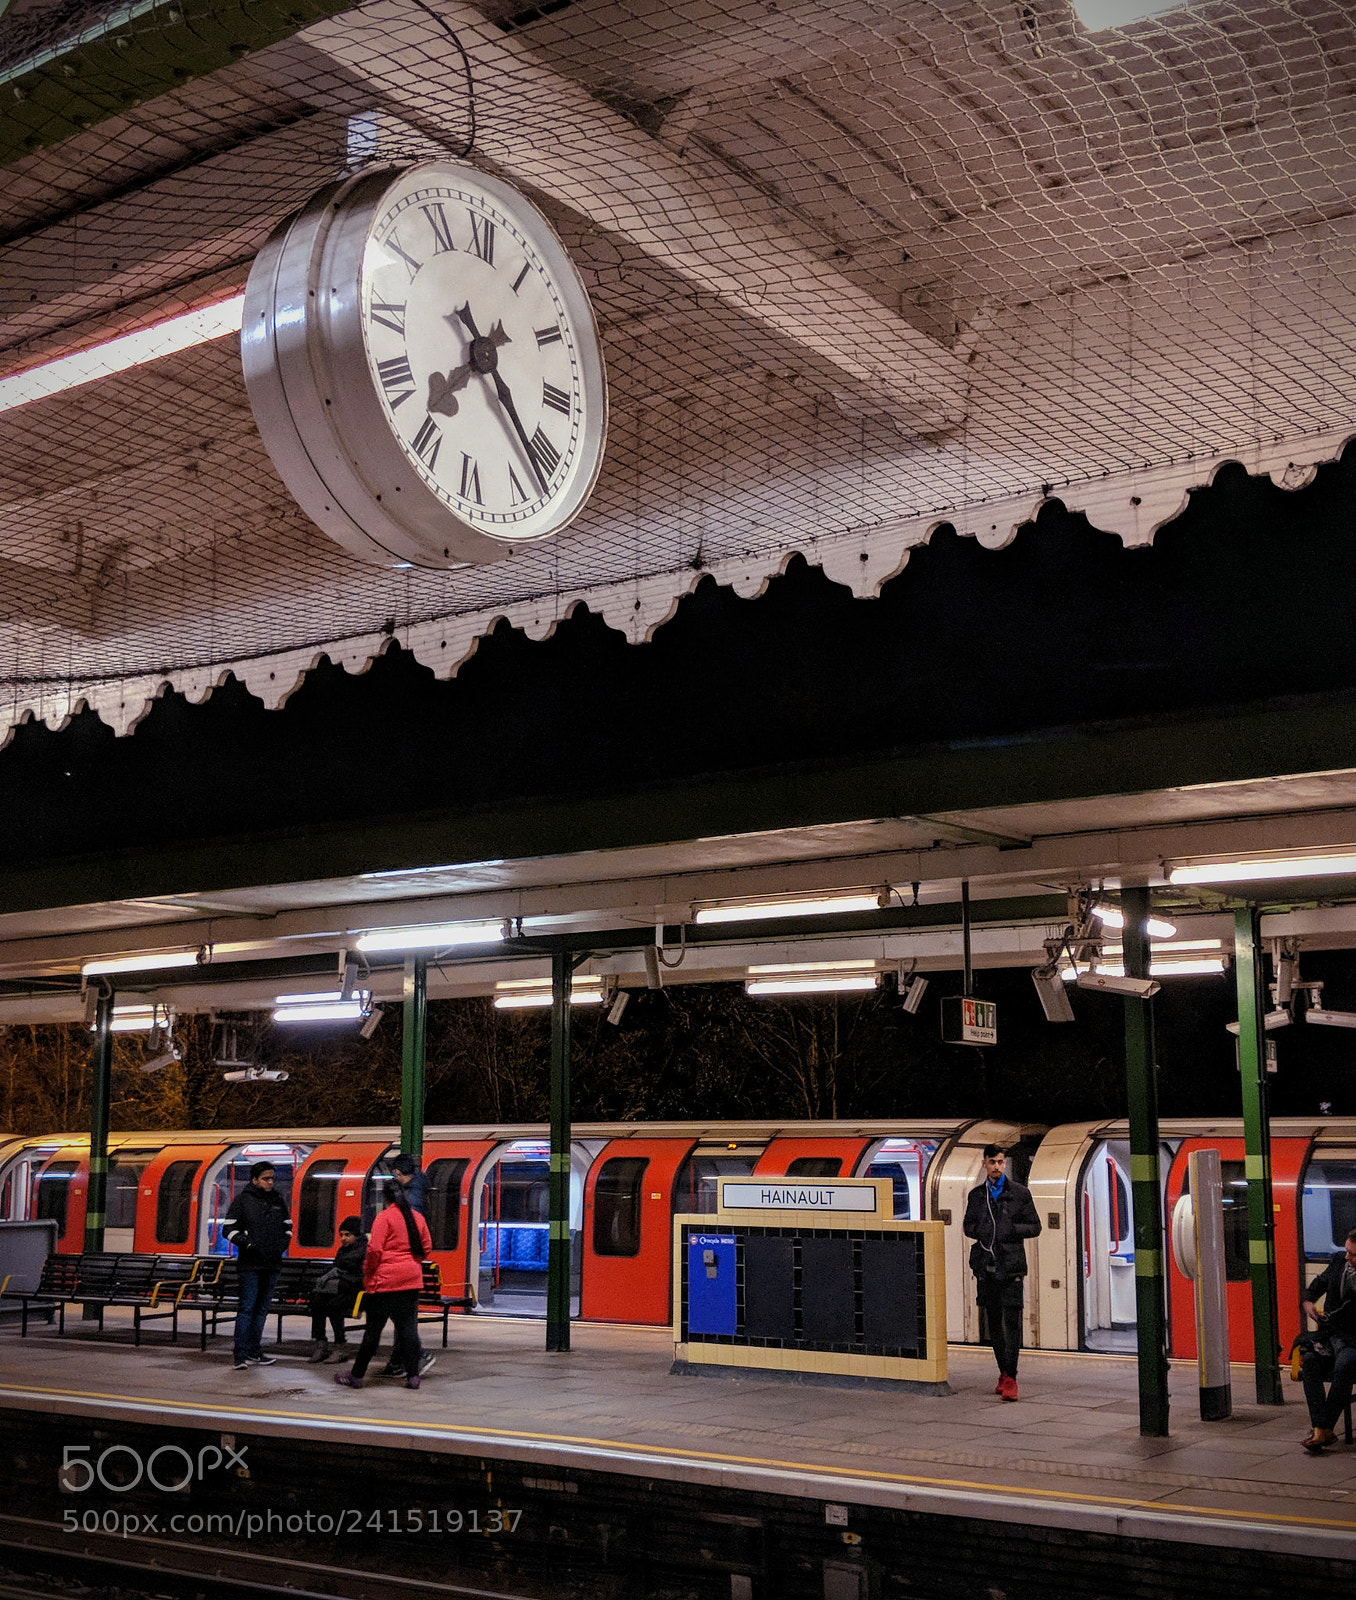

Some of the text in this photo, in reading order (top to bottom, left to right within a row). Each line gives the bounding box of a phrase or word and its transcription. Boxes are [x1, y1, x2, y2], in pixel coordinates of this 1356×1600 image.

[384, 227, 423, 284] X
[418, 202, 458, 256] XI
[465, 208, 498, 269] XII
[509, 257, 533, 297] I
[532, 321, 564, 351] II
[376, 350, 416, 415] VIII
[541, 377, 571, 420] III
[409, 412, 444, 475] VII
[457, 451, 485, 506] VI
[508, 461, 531, 507] V
[761, 1190, 834, 1205] HAINAULT
